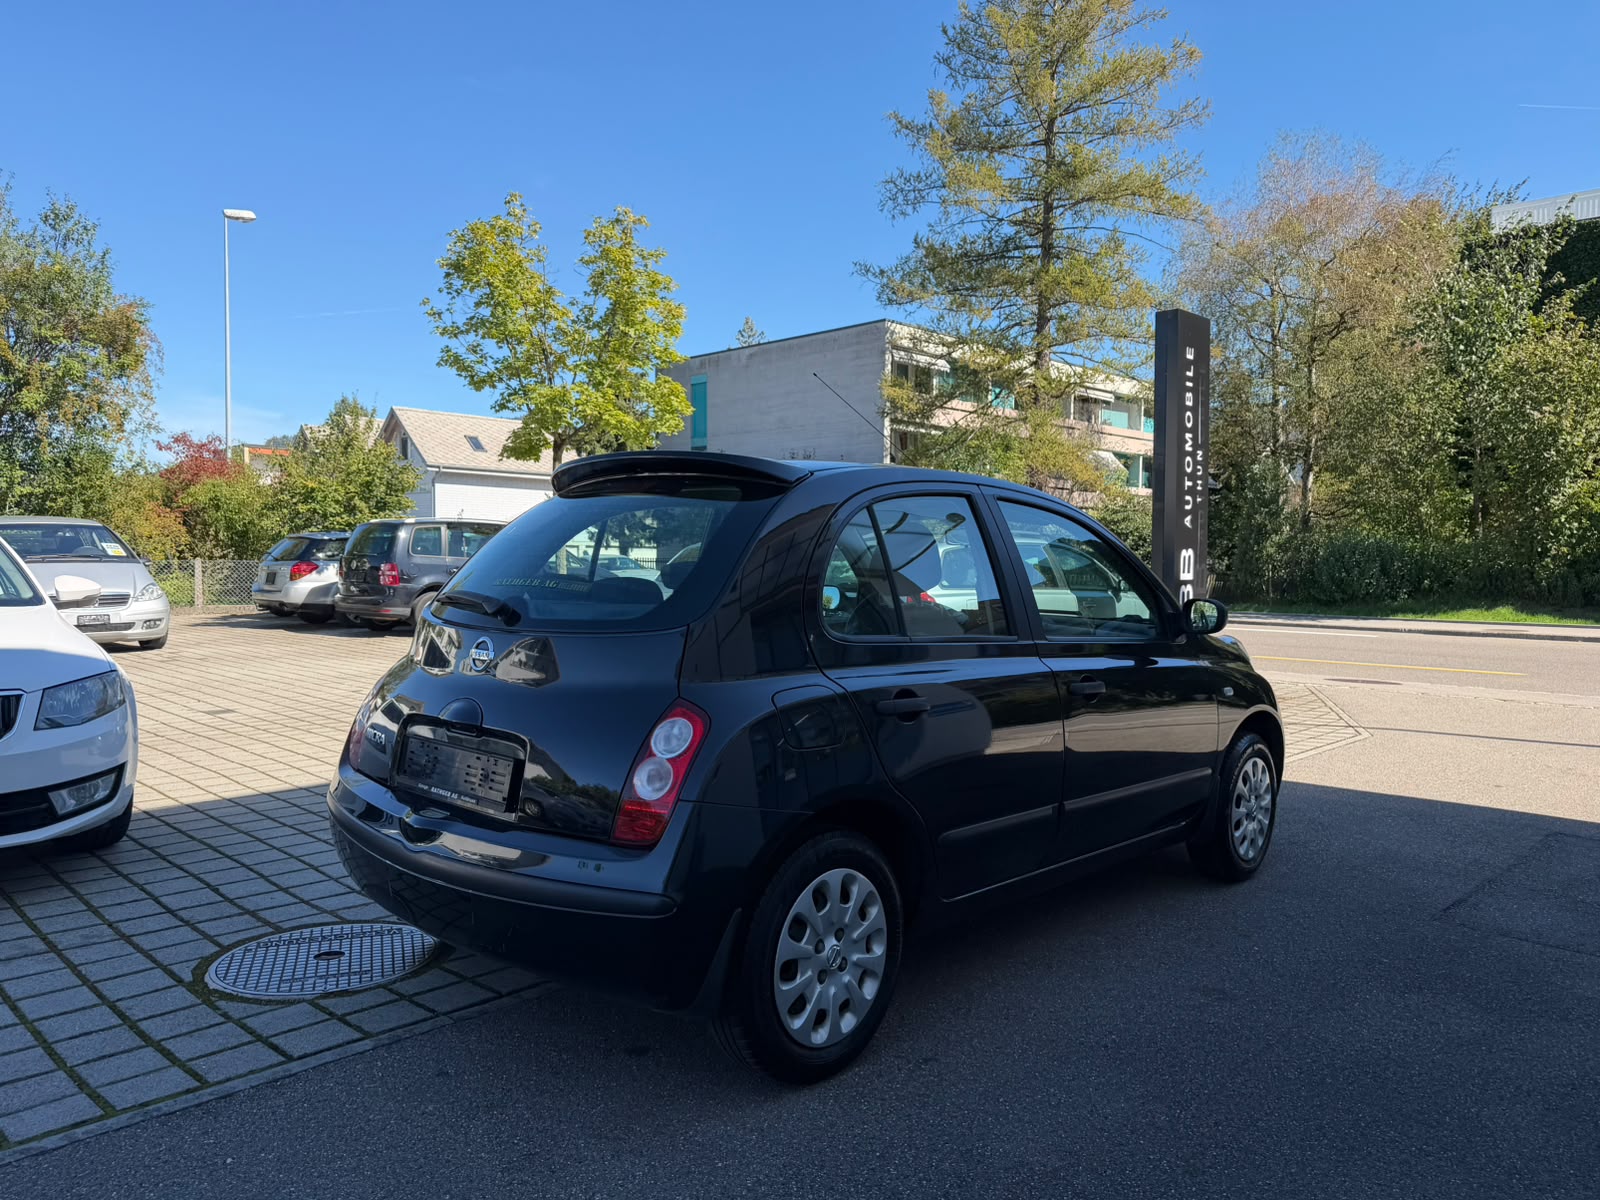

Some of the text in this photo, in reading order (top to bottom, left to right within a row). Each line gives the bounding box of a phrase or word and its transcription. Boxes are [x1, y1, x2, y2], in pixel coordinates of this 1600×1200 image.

[1184, 345, 1195, 529] AUTOMOBILE
[1196, 449, 1204, 503] THUN
[257, 928, 402, 948] VERSICKERUNG
